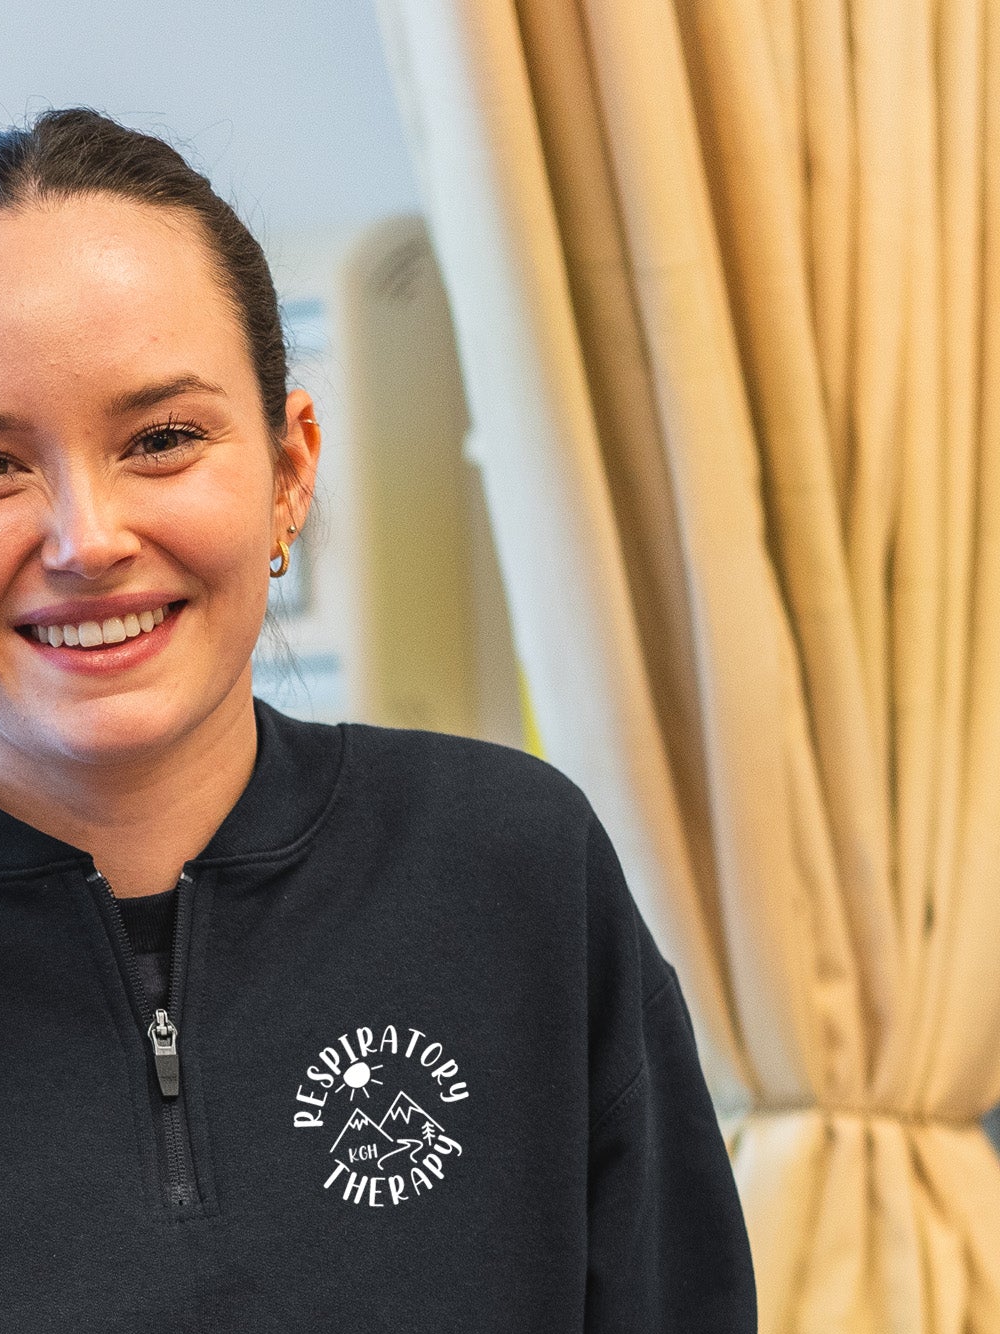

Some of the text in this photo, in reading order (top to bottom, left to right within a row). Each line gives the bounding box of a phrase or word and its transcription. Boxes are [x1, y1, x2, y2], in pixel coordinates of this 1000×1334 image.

[294, 1025, 469, 1127] RESPIRATORY
[323, 1134, 462, 1207] THERAPY
[349, 1144, 378, 1162] KGH
